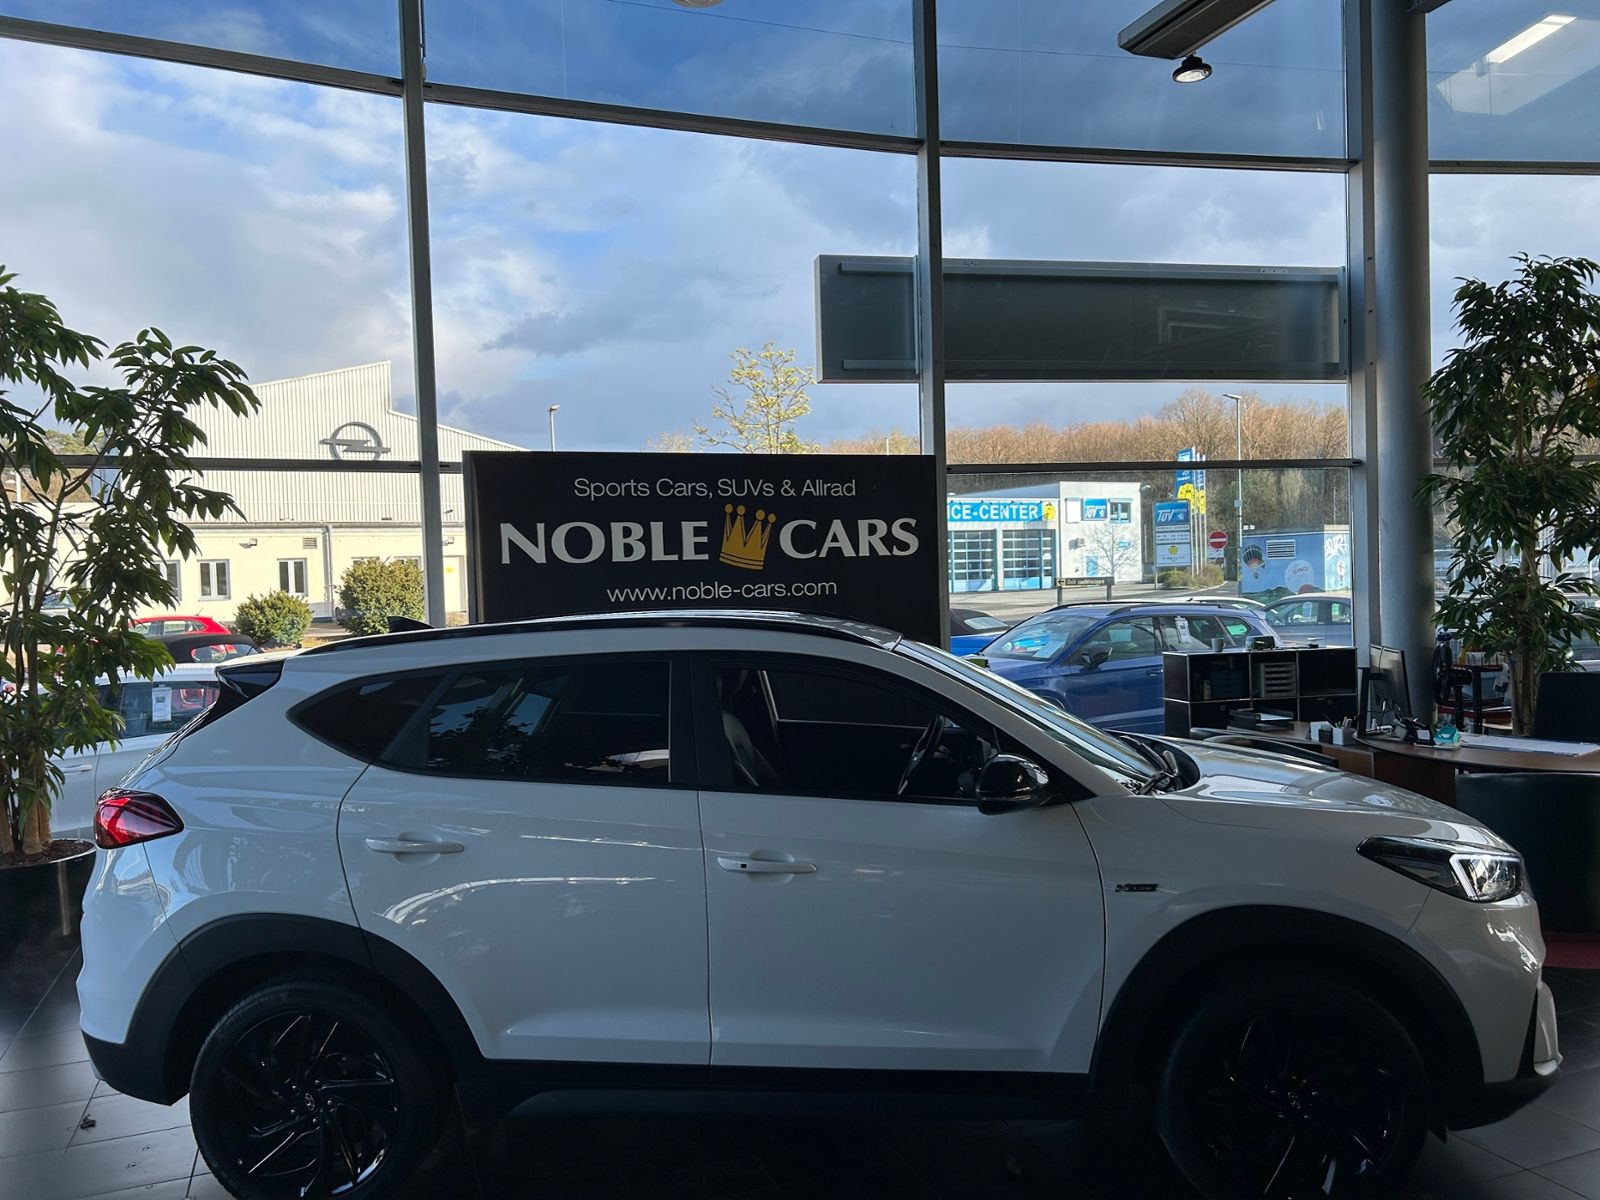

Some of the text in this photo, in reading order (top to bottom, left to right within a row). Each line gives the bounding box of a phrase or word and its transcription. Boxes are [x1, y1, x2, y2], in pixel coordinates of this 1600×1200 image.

[574, 477, 856, 501] Sports Cars, SUVs & Allrad
[500, 517, 920, 565] NOBLE CARS
[606, 581, 838, 602] www.noble-cars.com
